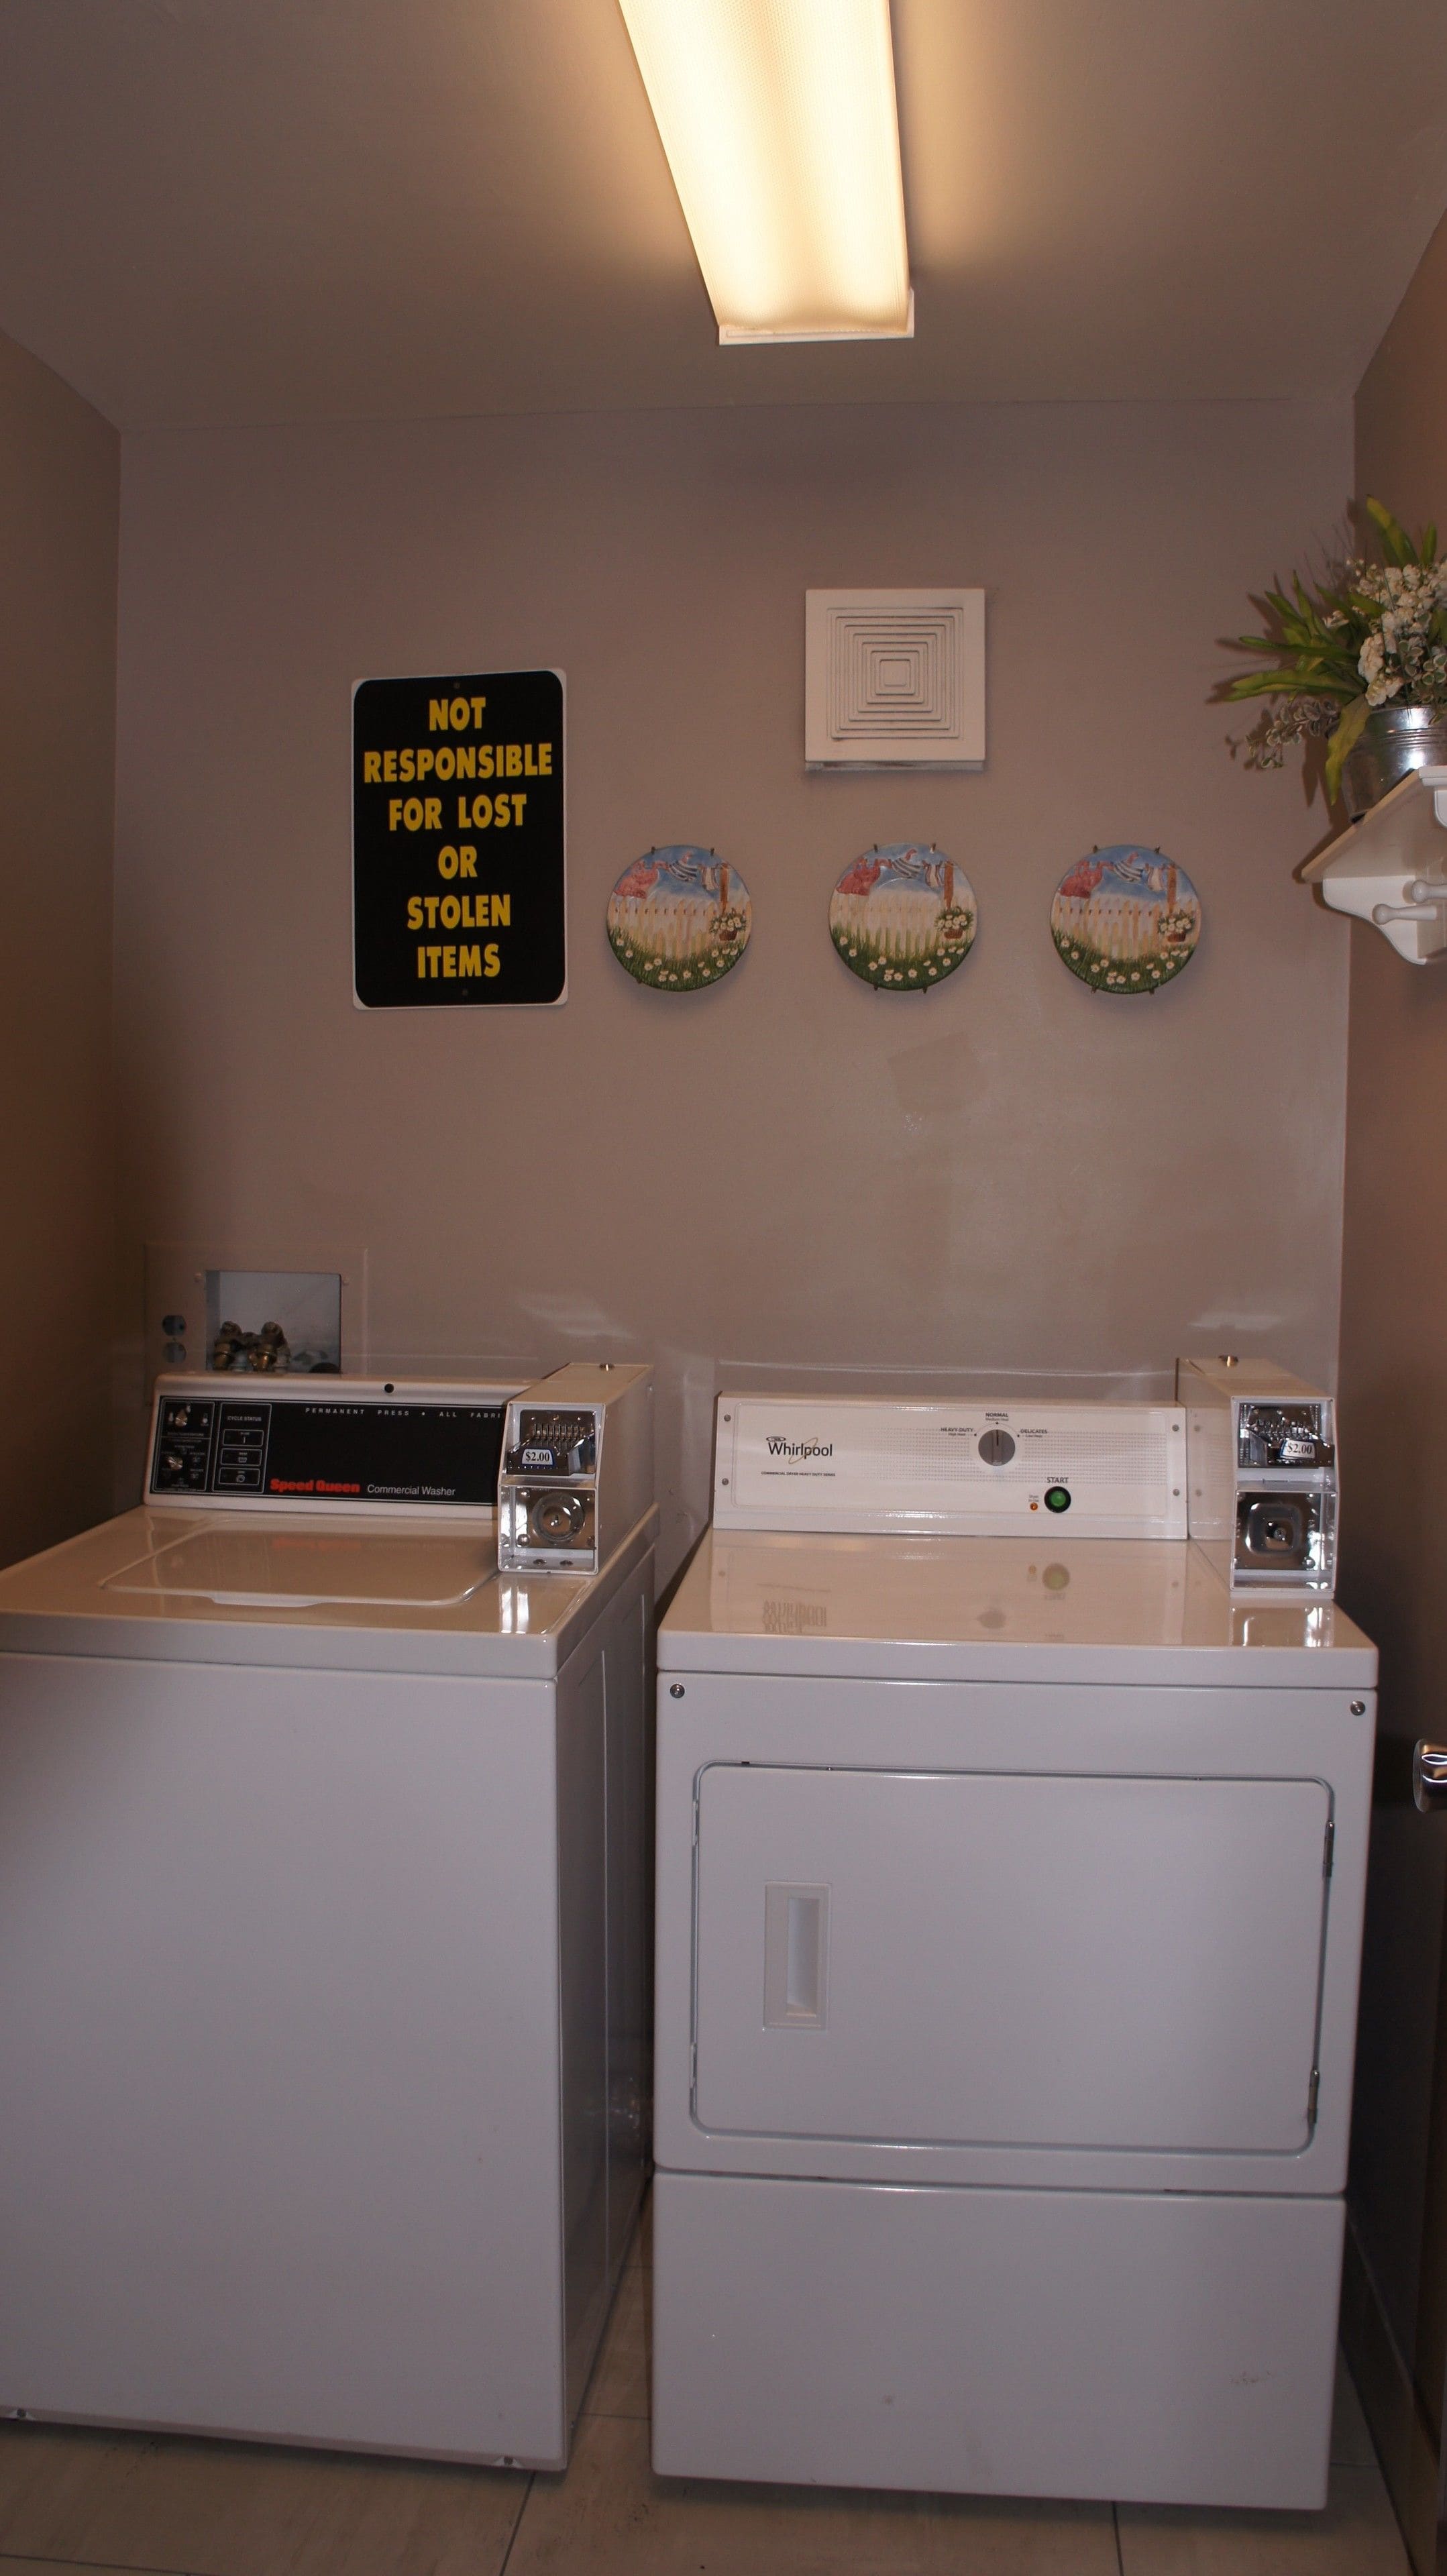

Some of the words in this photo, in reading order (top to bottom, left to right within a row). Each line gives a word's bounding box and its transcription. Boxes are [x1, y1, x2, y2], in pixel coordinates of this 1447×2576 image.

[429, 697, 486, 731] NOT
[364, 743, 553, 784] RESPONSIBLE
[389, 798, 443, 831] FOR
[458, 794, 527, 829] LOST
[438, 845, 478, 879] OR
[407, 894, 511, 930] STOLEN
[417, 943, 501, 979] ITEMS
[525, 1451, 550, 1462] $2.00
[768, 1442, 833, 1459] Whirlpool
[1287, 1443, 1312, 1454] $2.00
[270, 1478, 314, 1493] Speed
[315, 1479, 361, 1493] Queen
[367, 1484, 419, 1495] Commercial
[421, 1485, 456, 1496] Washer
